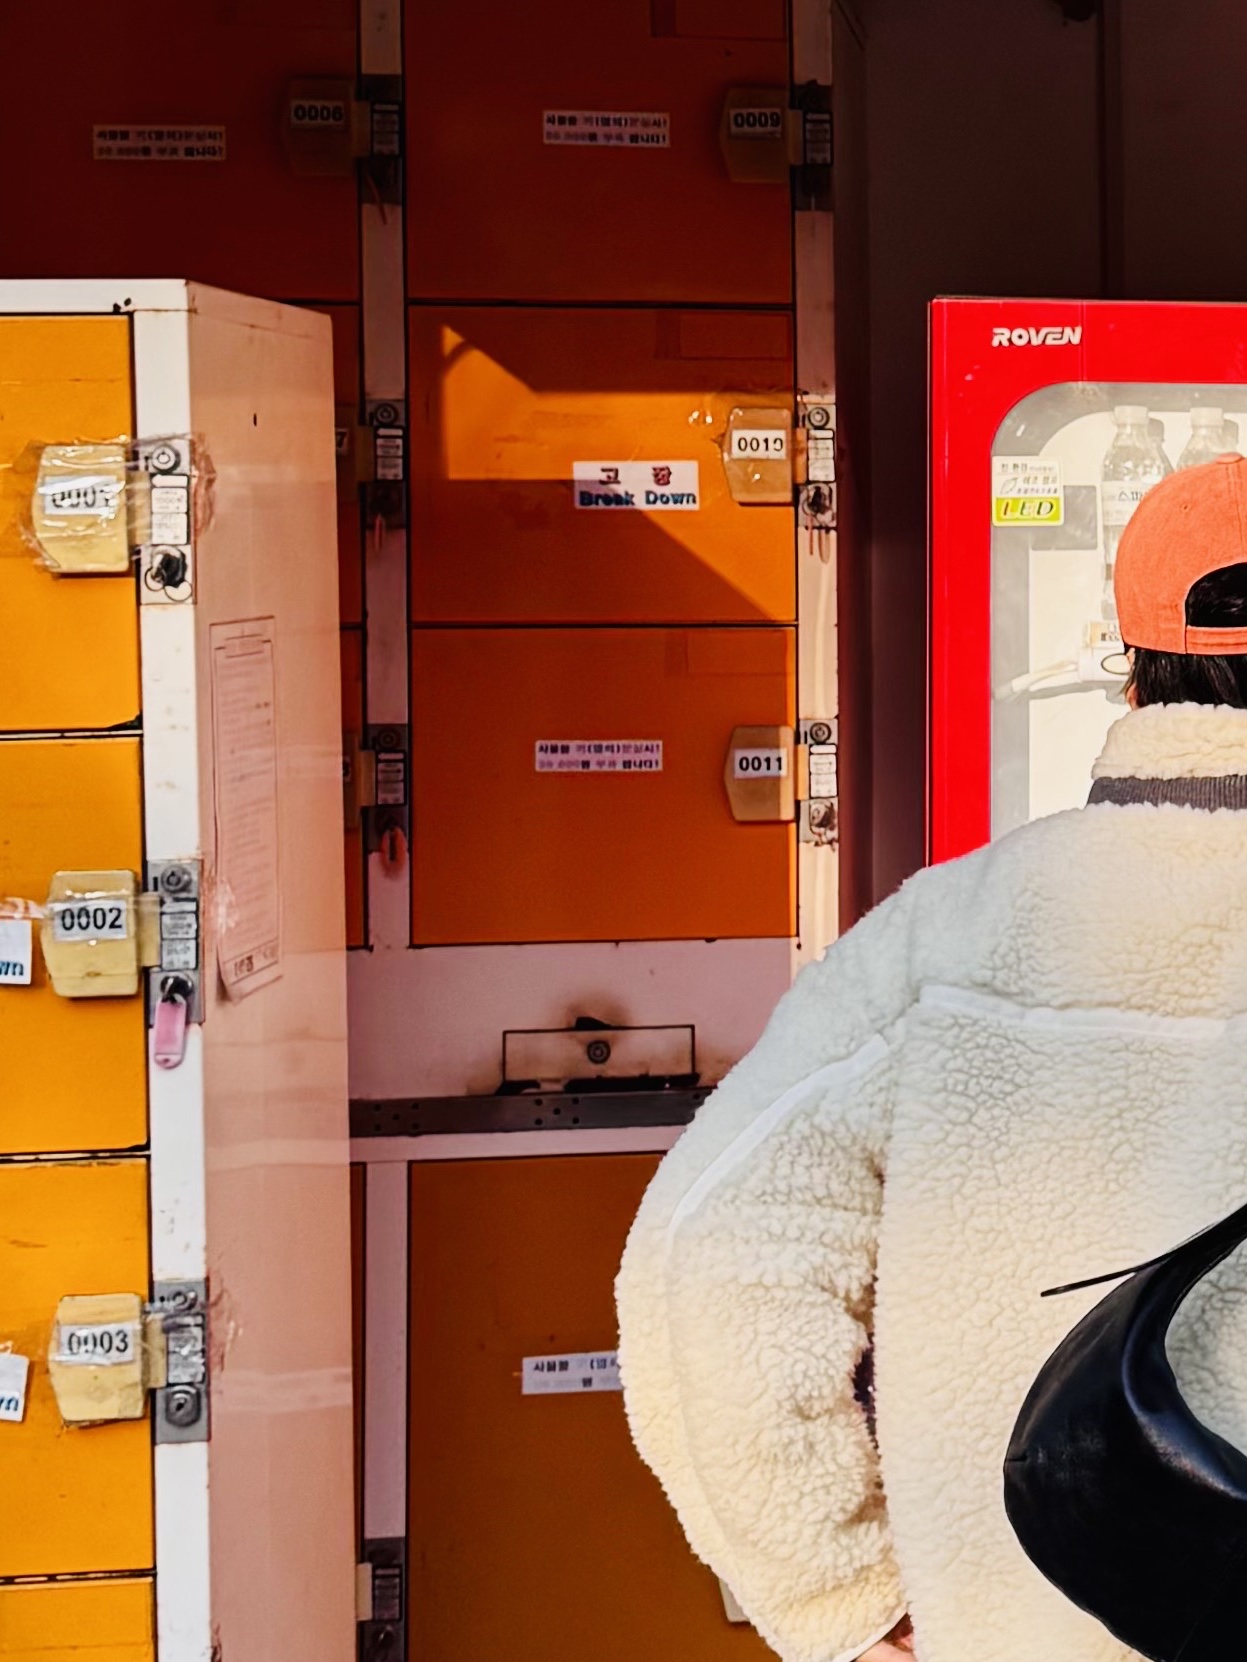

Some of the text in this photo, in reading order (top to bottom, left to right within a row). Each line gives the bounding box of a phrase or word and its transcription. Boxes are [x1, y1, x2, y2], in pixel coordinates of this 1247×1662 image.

[294, 104, 343, 121] 0006
[734, 112, 781, 128] 0009
[991, 325, 1082, 347] ROVEN
[579, 490, 697, 506] Break Down
[1003, 501, 1054, 516] LED
[739, 756, 783, 771] 0011
[61, 907, 123, 931] 0002
[68, 1329, 128, 1353] 0003
